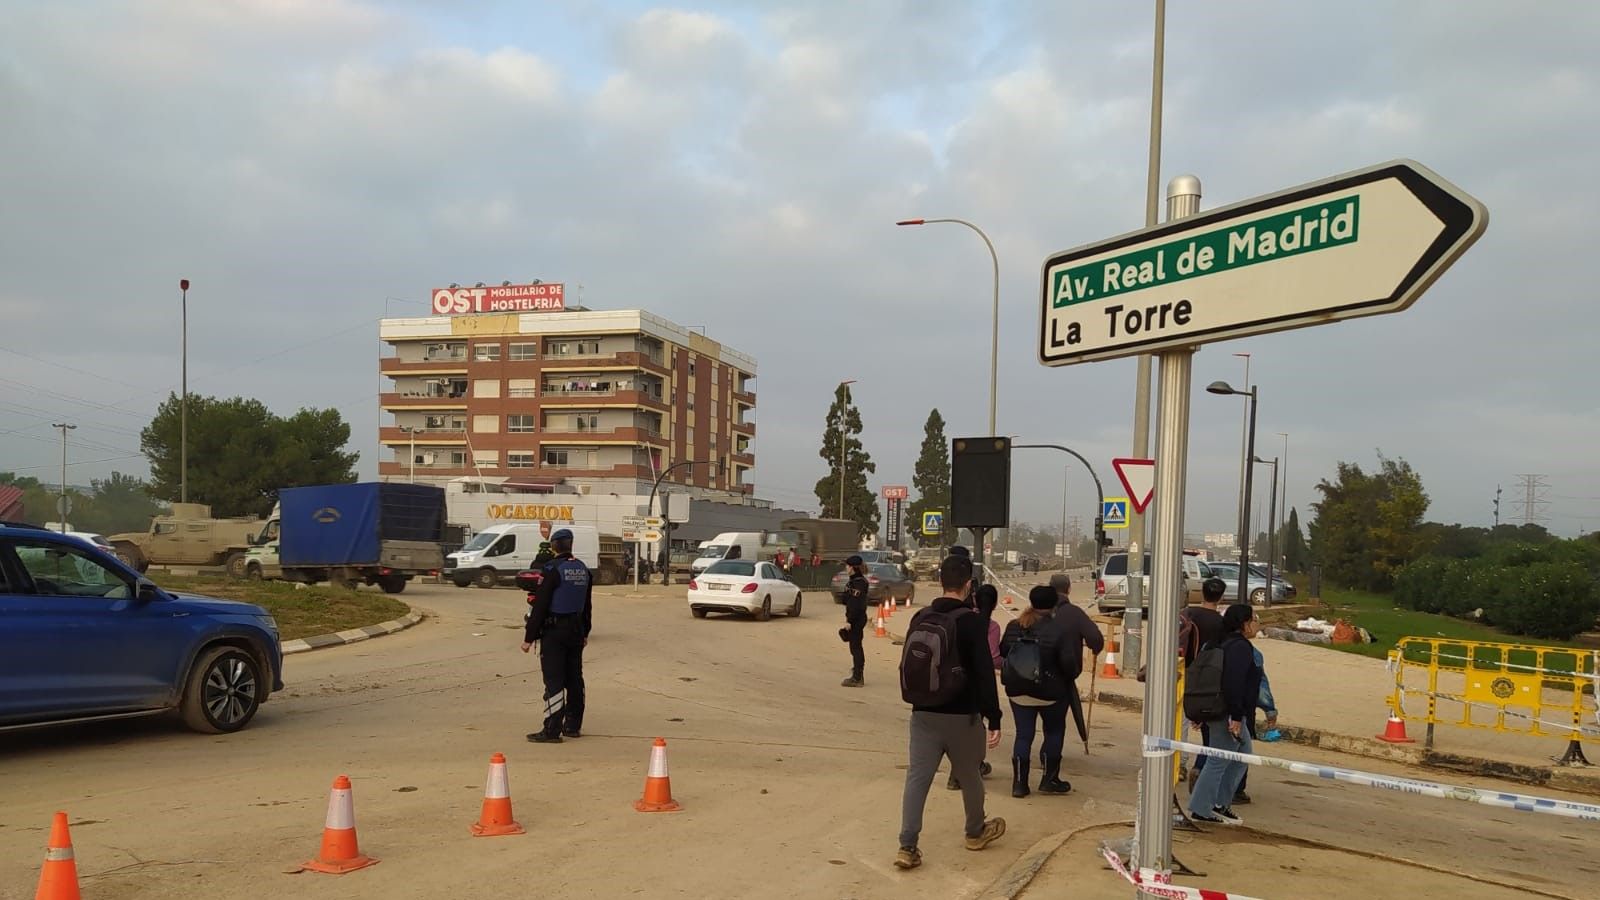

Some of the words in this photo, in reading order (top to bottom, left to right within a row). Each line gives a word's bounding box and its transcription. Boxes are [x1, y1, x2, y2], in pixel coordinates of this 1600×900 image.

[1055, 274, 1094, 303] Av.
[1103, 250, 1165, 292] Real
[1177, 242, 1214, 275] de
[1227, 202, 1355, 264] Madrid
[434, 289, 486, 313] OST
[490, 287, 545, 297] MOBILIARIO
[549, 286, 562, 294] DE
[491, 298, 562, 311] HOSTELERIA
[1050, 318, 1081, 348] La
[1105, 299, 1192, 338] Torre
